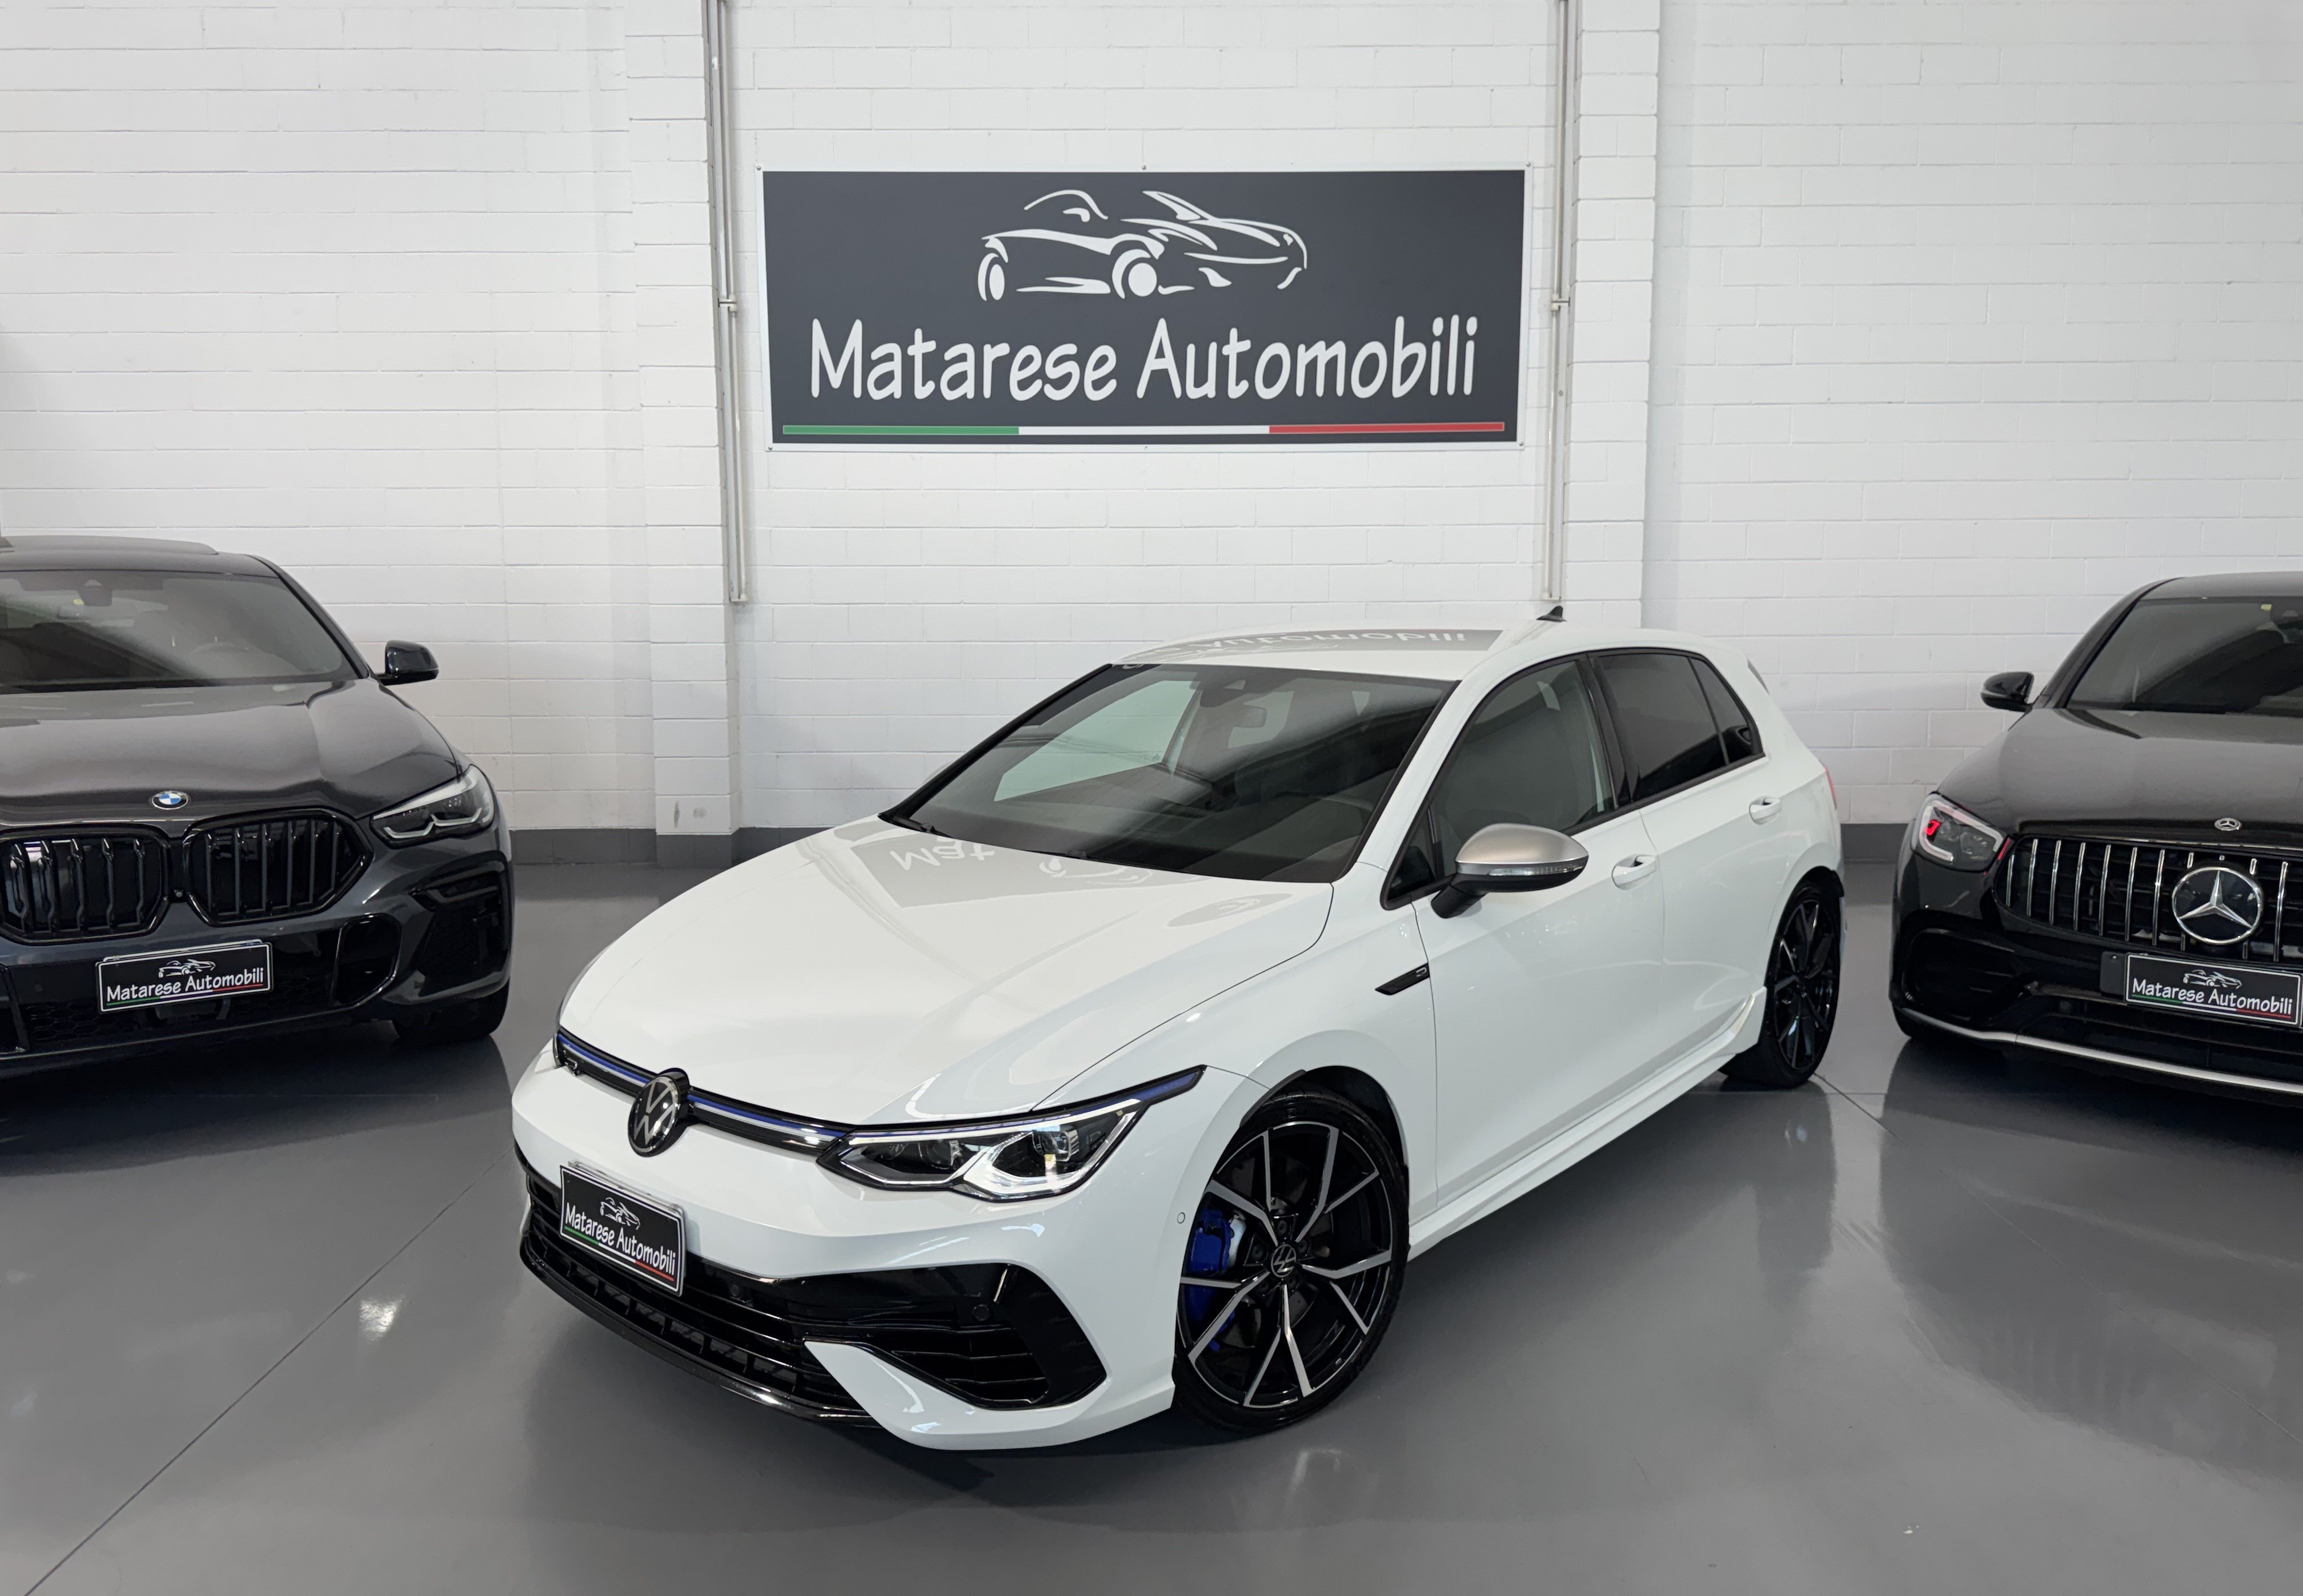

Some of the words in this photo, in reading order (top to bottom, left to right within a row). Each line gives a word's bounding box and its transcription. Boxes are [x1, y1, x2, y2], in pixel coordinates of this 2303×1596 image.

[811, 318, 1117, 401] Matarese
[1136, 315, 1478, 400] Automobili
[107, 982, 182, 1002] Matarese
[185, 967, 264, 992] Automobili
[2132, 978, 2205, 1003] Matarese
[2208, 988, 2293, 1015] Automobili
[565, 1202, 615, 1247] Matarese
[616, 1227, 676, 1276] Automobili
